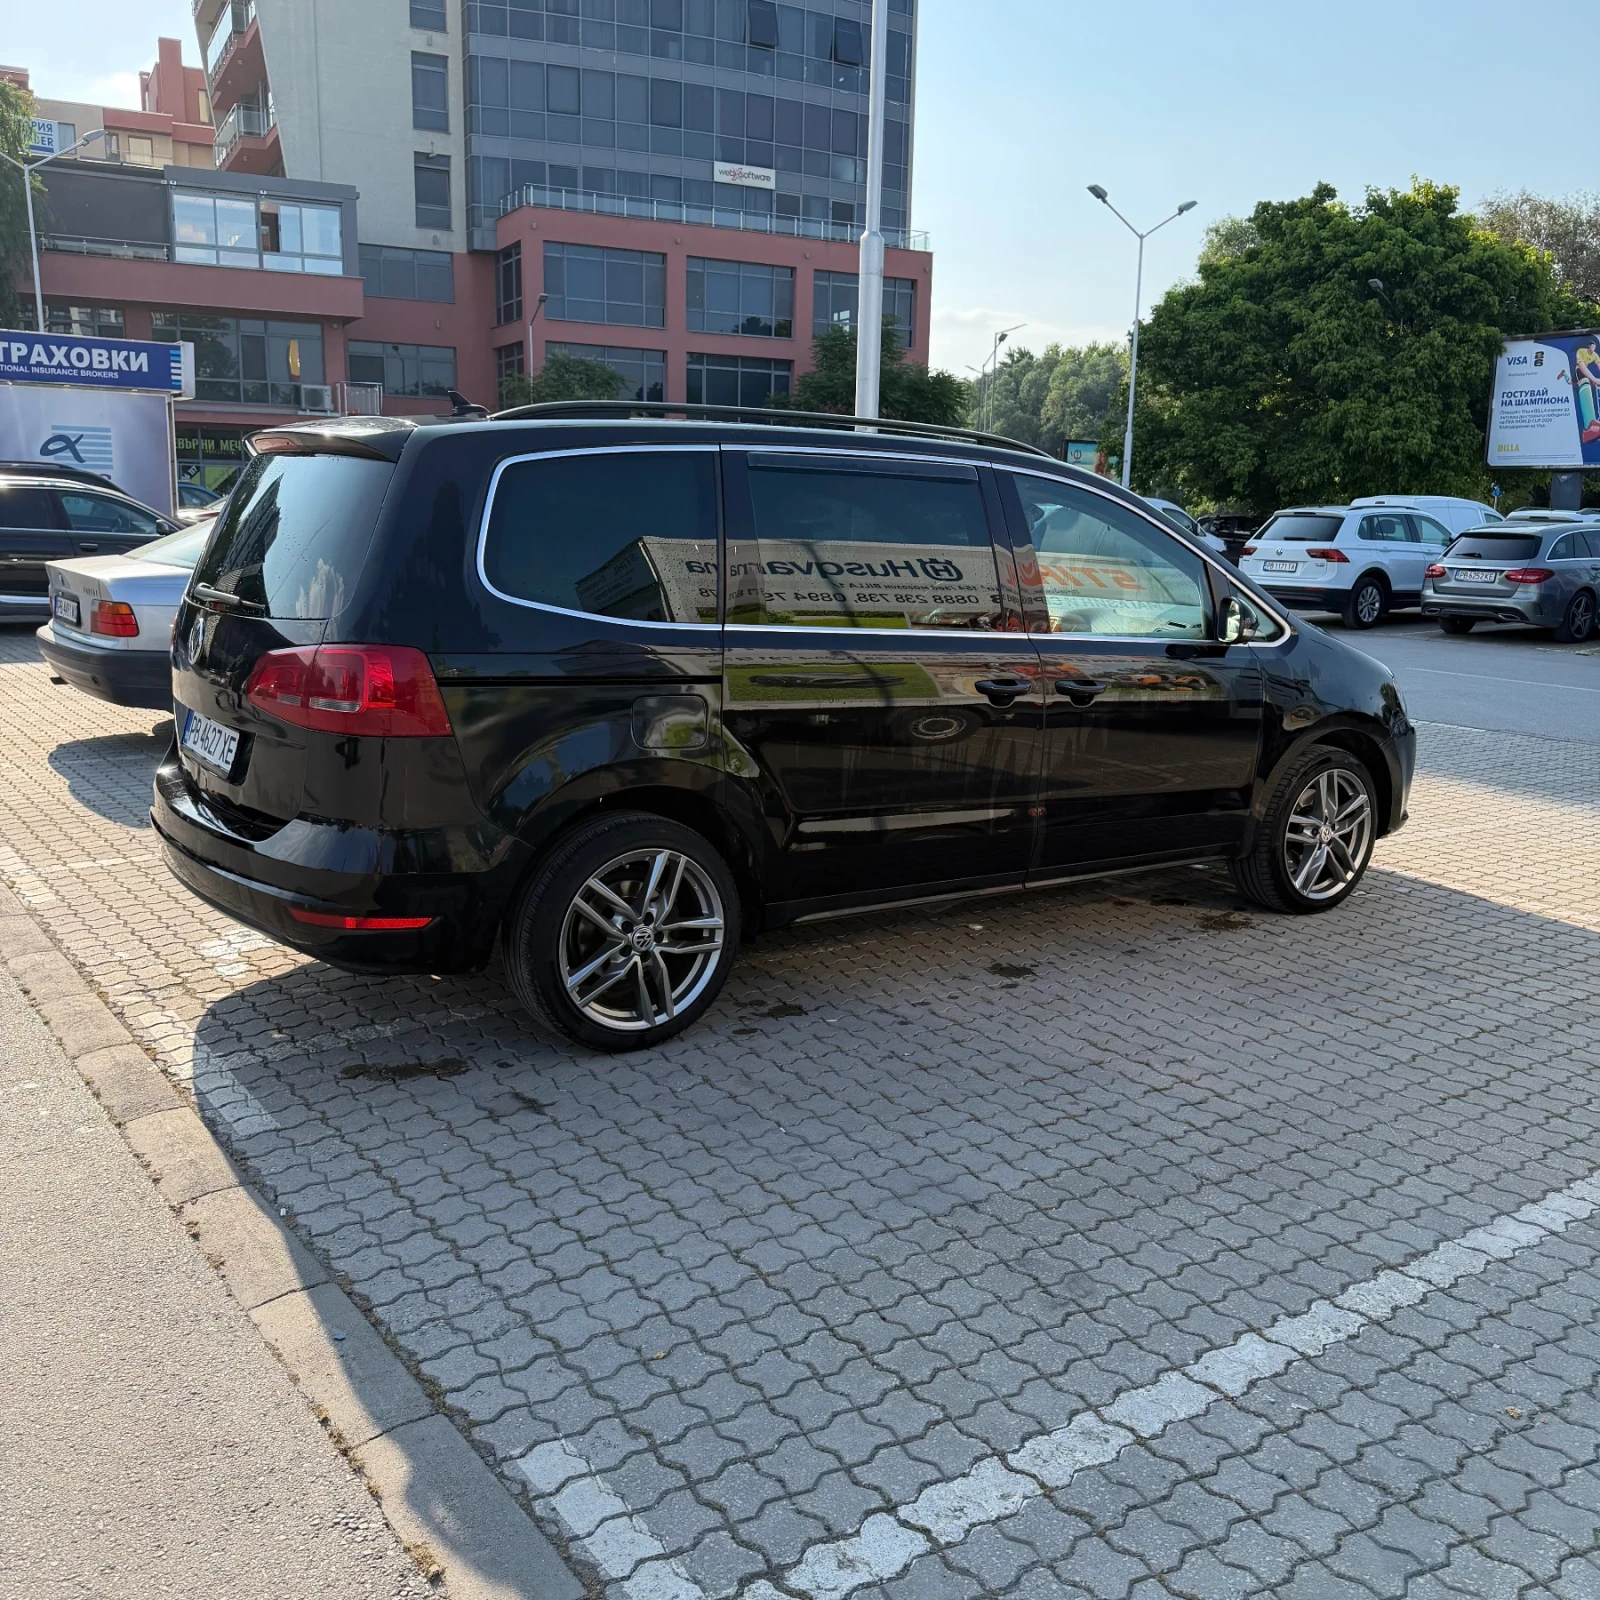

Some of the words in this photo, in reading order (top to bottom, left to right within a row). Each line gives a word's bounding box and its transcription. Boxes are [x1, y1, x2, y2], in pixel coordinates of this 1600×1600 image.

[31, 121, 53, 133] РИЯ
[1506, 356, 1528, 366] VISA
[31, 367, 79, 377] INSURANCE
[80, 369, 119, 379] BROKERS
[1502, 387, 1548, 399] ГОСТУВАЙ
[1501, 398, 1513, 407] НА
[1514, 396, 1570, 407] ШАМПИОНА
[1497, 444, 1520, 452] BILLA
[189, 715, 202, 745] PB
[200, 722, 223, 757] 4627
[219, 732, 237, 765] XE
